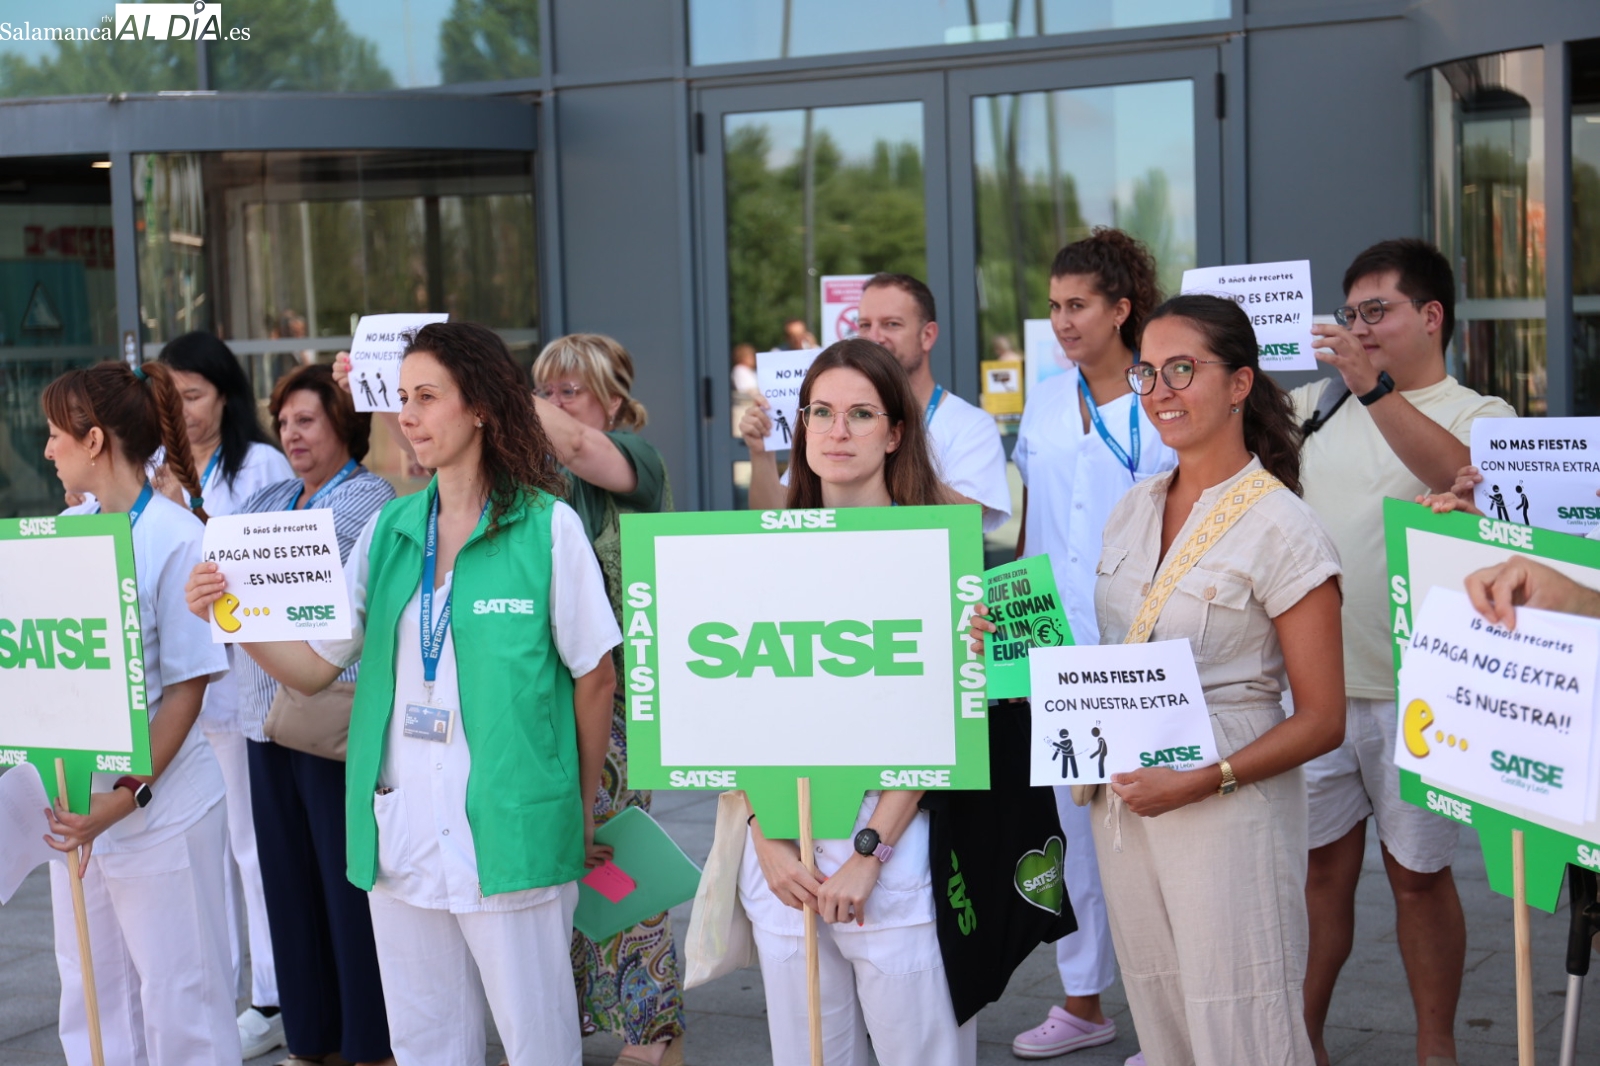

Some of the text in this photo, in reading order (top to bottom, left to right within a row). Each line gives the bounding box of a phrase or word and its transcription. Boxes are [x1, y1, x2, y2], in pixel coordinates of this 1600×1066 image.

[1248, 274, 1257, 282] de
[1259, 273, 1294, 281] recortes
[1248, 293, 1262, 304] ES
[1264, 290, 1304, 303] EXTRA
[365, 333, 378, 342] NO
[378, 333, 395, 342] MAS
[354, 351, 403, 360] CON NUESTR
[776, 370, 792, 380] NO
[765, 389, 786, 398] CON
[1490, 439, 1588, 450] NO MAS FIESTAS
[1481, 460, 1505, 471] CON
[1508, 461, 1560, 472] NUESTRA
[20, 517, 56, 536] SATSE
[760, 509, 836, 530] SATSE
[244, 526, 250, 535] 15
[272, 524, 282, 533] de
[284, 523, 318, 532] recortes
[1478, 518, 1534, 550] SATSE
[218, 548, 250, 562] PAGA
[253, 548, 270, 560] NO
[274, 546, 288, 559] ES
[290, 544, 331, 558] EXTRA
[266, 570, 332, 584] NUESTRA!!
[1012, 568, 1028, 578] EXTRA
[988, 578, 1032, 604] QUE NO
[286, 605, 336, 621] SATSE
[472, 598, 534, 615] SATSE
[988, 593, 1056, 623] SE COMAN
[992, 618, 1032, 642] NI UN
[1470, 618, 1482, 630] 15
[1523, 634, 1574, 654] recortes
[0, 618, 111, 670] SATSE
[121, 578, 146, 710] SATSE
[627, 582, 655, 721] SATSE
[686, 618, 924, 680] SATSE
[1412, 632, 1580, 693] LA PAGA NO ES EXTRA
[1058, 668, 1166, 685] NO MAS FIESTAS
[1044, 693, 1189, 713] CON NUESTRA EXTRA
[1476, 694, 1571, 734] NUESTRA!!
[96, 754, 132, 772] SATSE
[1139, 745, 1204, 768] SATSE
[880, 770, 950, 787] SATSE
[1490, 750, 1564, 789] SATSE
[670, 770, 737, 788] SATSE
[1501, 774, 1526, 790] Castilla
[1426, 790, 1473, 824] SATSE
[1023, 866, 1057, 892] SATSE
